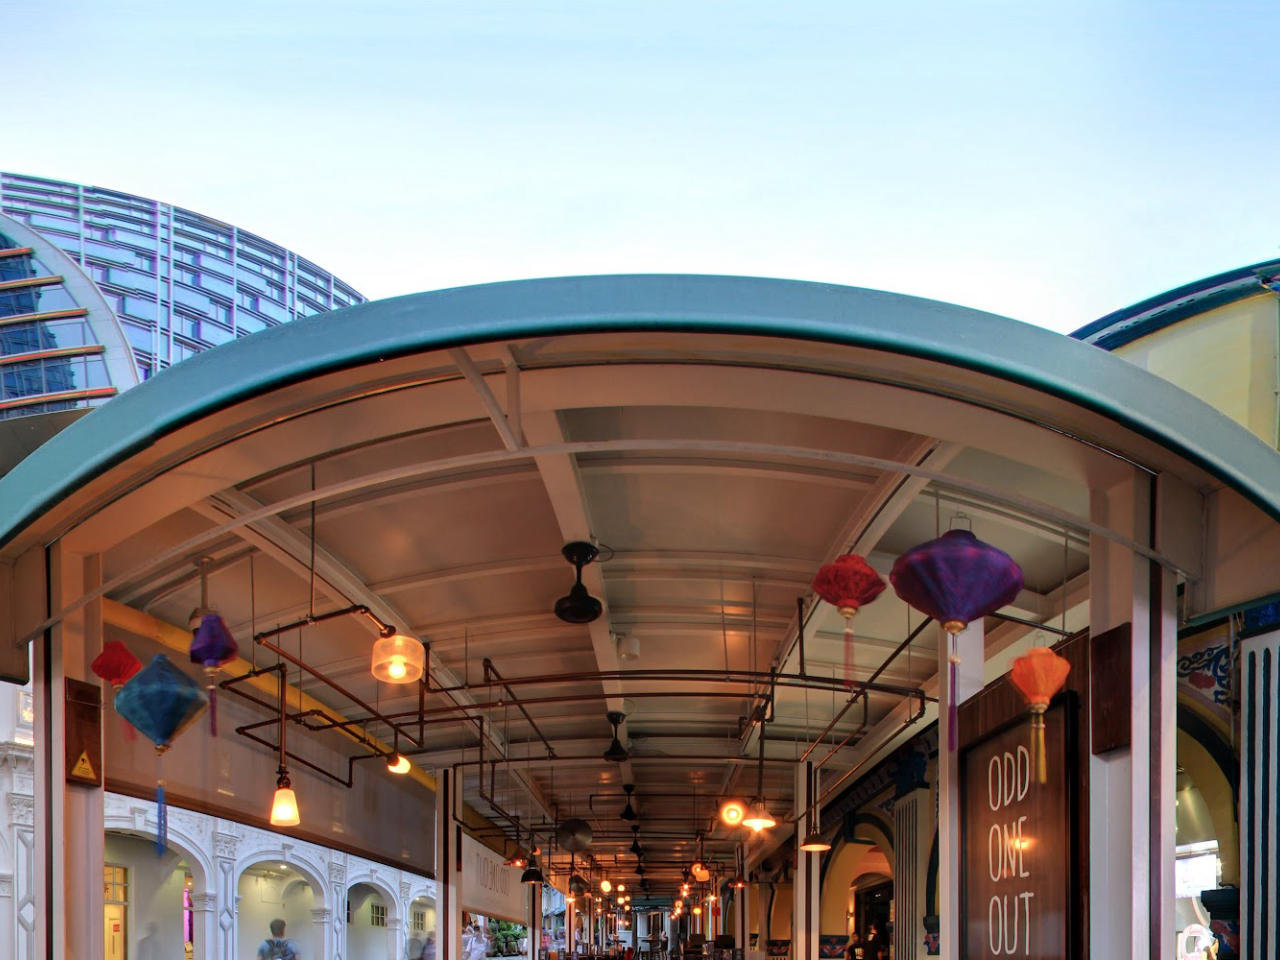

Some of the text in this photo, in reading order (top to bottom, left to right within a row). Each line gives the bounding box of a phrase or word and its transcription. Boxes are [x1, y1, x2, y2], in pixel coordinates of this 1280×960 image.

[989, 745, 1030, 812] ODD
[989, 815, 1030, 882] ONE
[989, 891, 1035, 956] OUT
